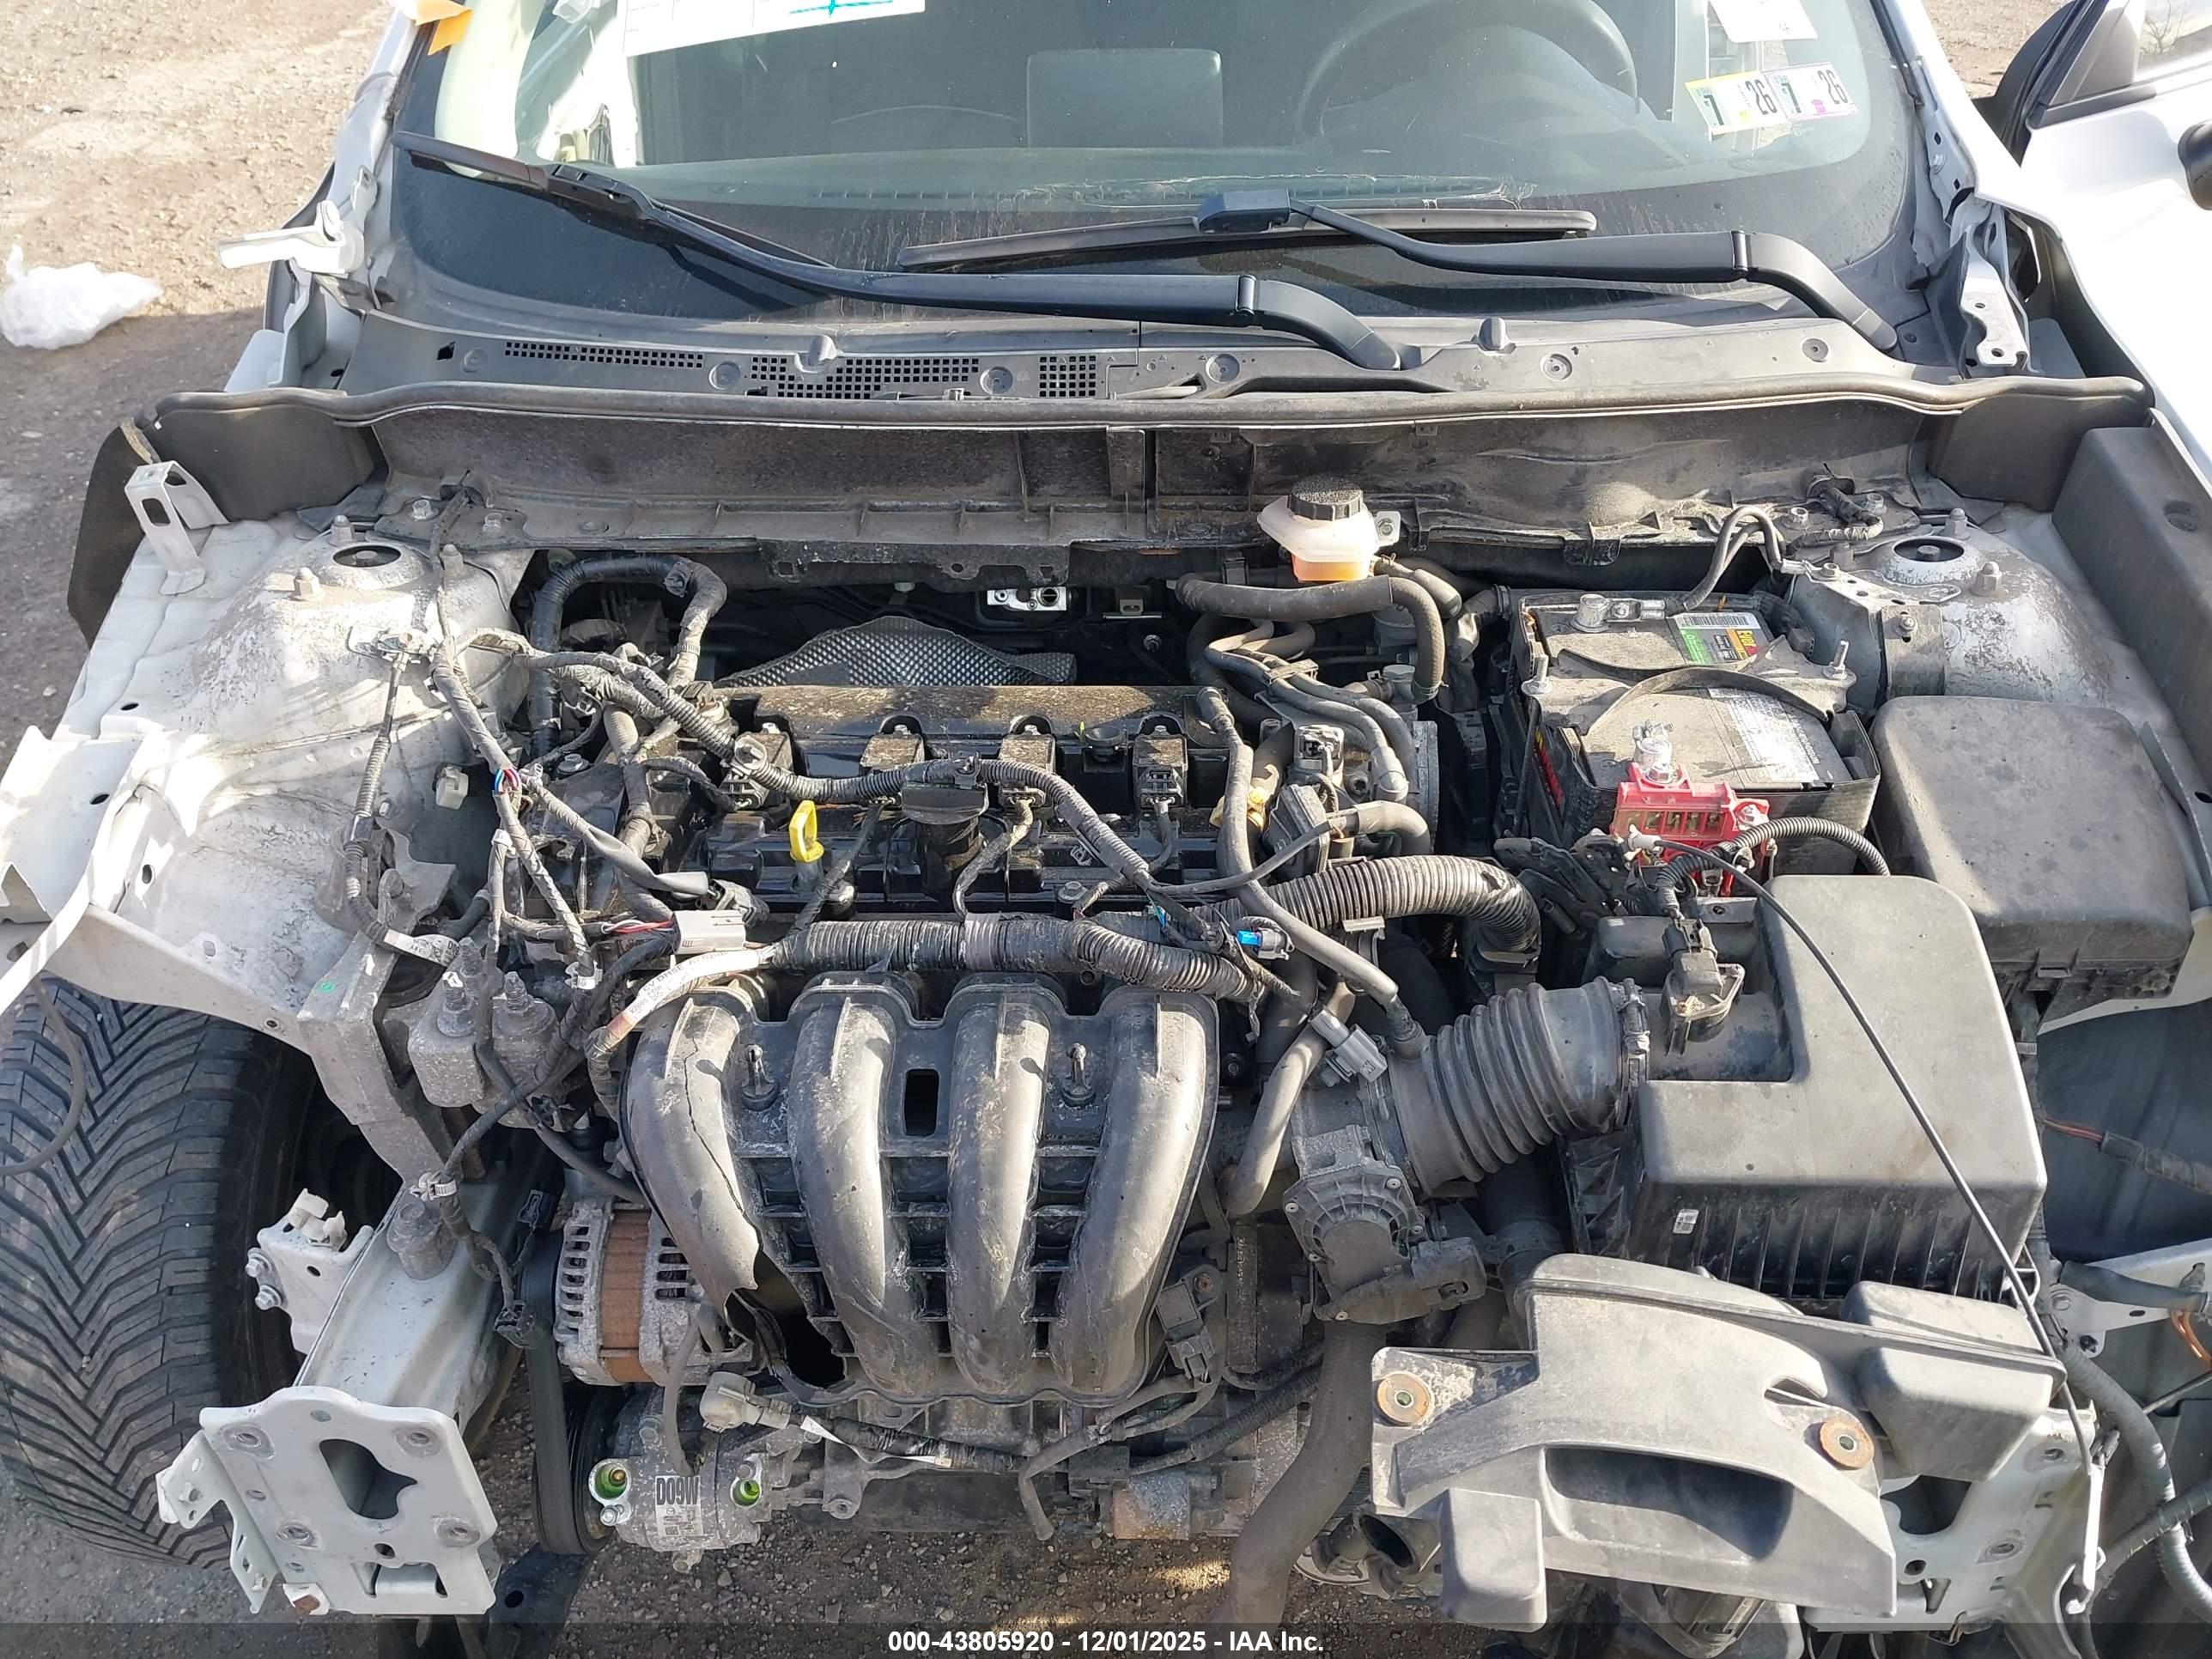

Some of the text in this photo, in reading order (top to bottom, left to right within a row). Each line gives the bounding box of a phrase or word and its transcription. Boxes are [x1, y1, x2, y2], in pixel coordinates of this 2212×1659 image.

[1744, 79, 1778, 116] 26
[1817, 69, 1849, 105] 26
[656, 1476, 700, 1505] D09W
